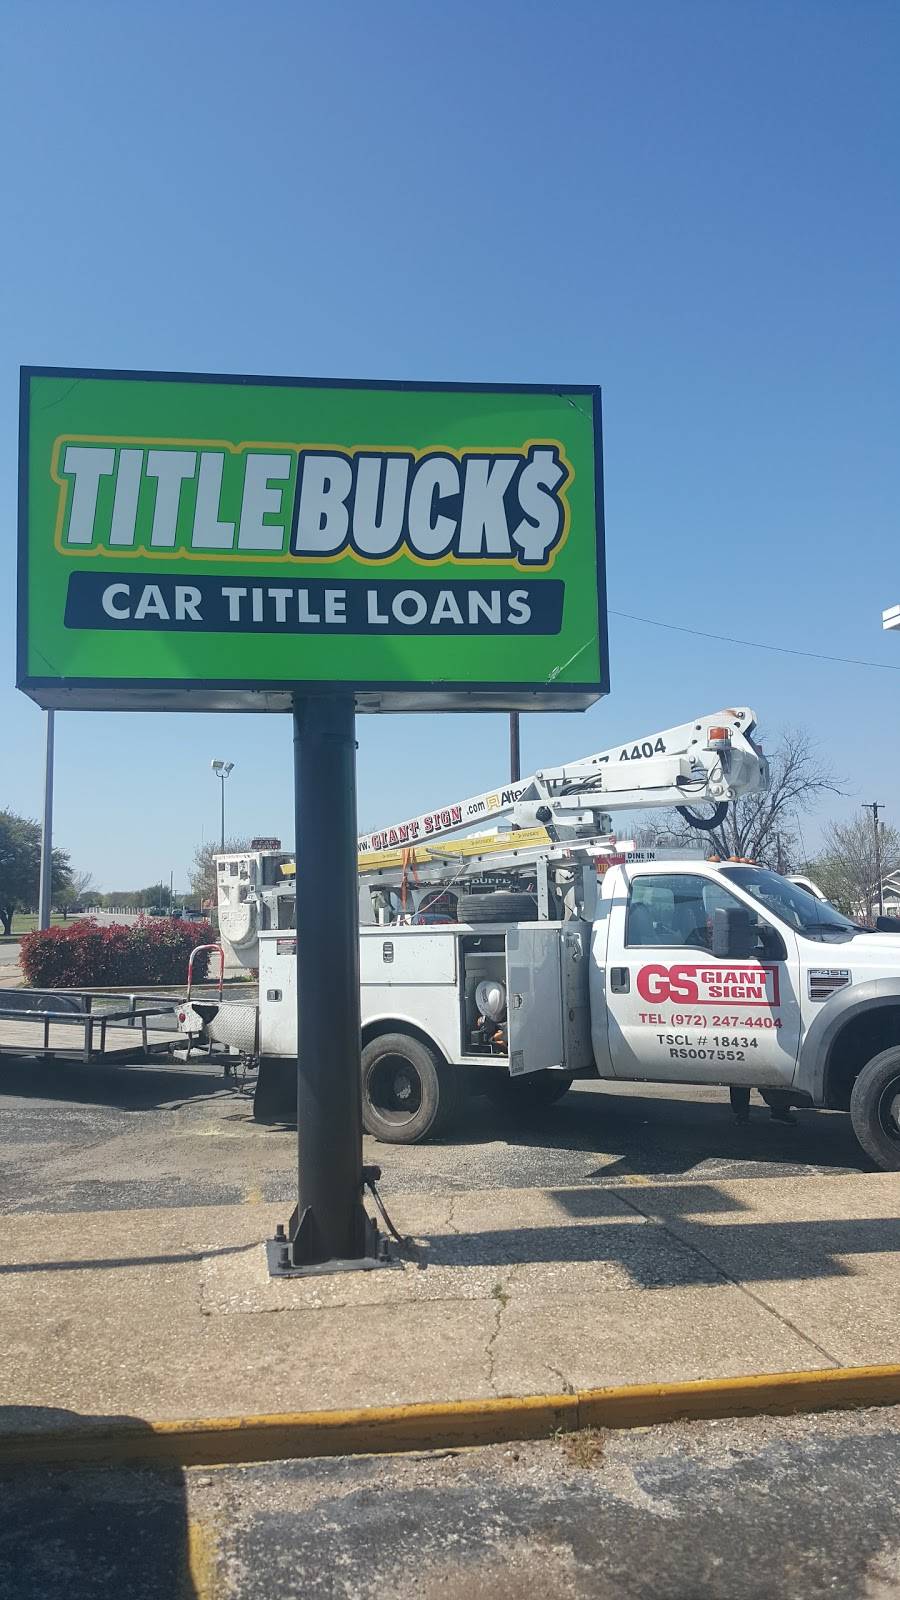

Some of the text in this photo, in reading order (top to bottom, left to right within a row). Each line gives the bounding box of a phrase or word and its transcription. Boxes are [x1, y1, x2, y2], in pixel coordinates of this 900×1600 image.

[101, 582, 533, 626] CAR TITLE LOANS
[371, 821, 420, 851] GIANT
[423, 806, 463, 834] SIGN
[466, 799, 486, 816] .com
[637, 964, 698, 1004] GS
[701, 971, 767, 985] GIANT
[708, 985, 763, 998] SIGN
[639, 1013, 783, 1029] TEL (972) 247-4404
[657, 1034, 758, 1048] TSCL # 18434
[670, 1048, 746, 1061] RS007552
